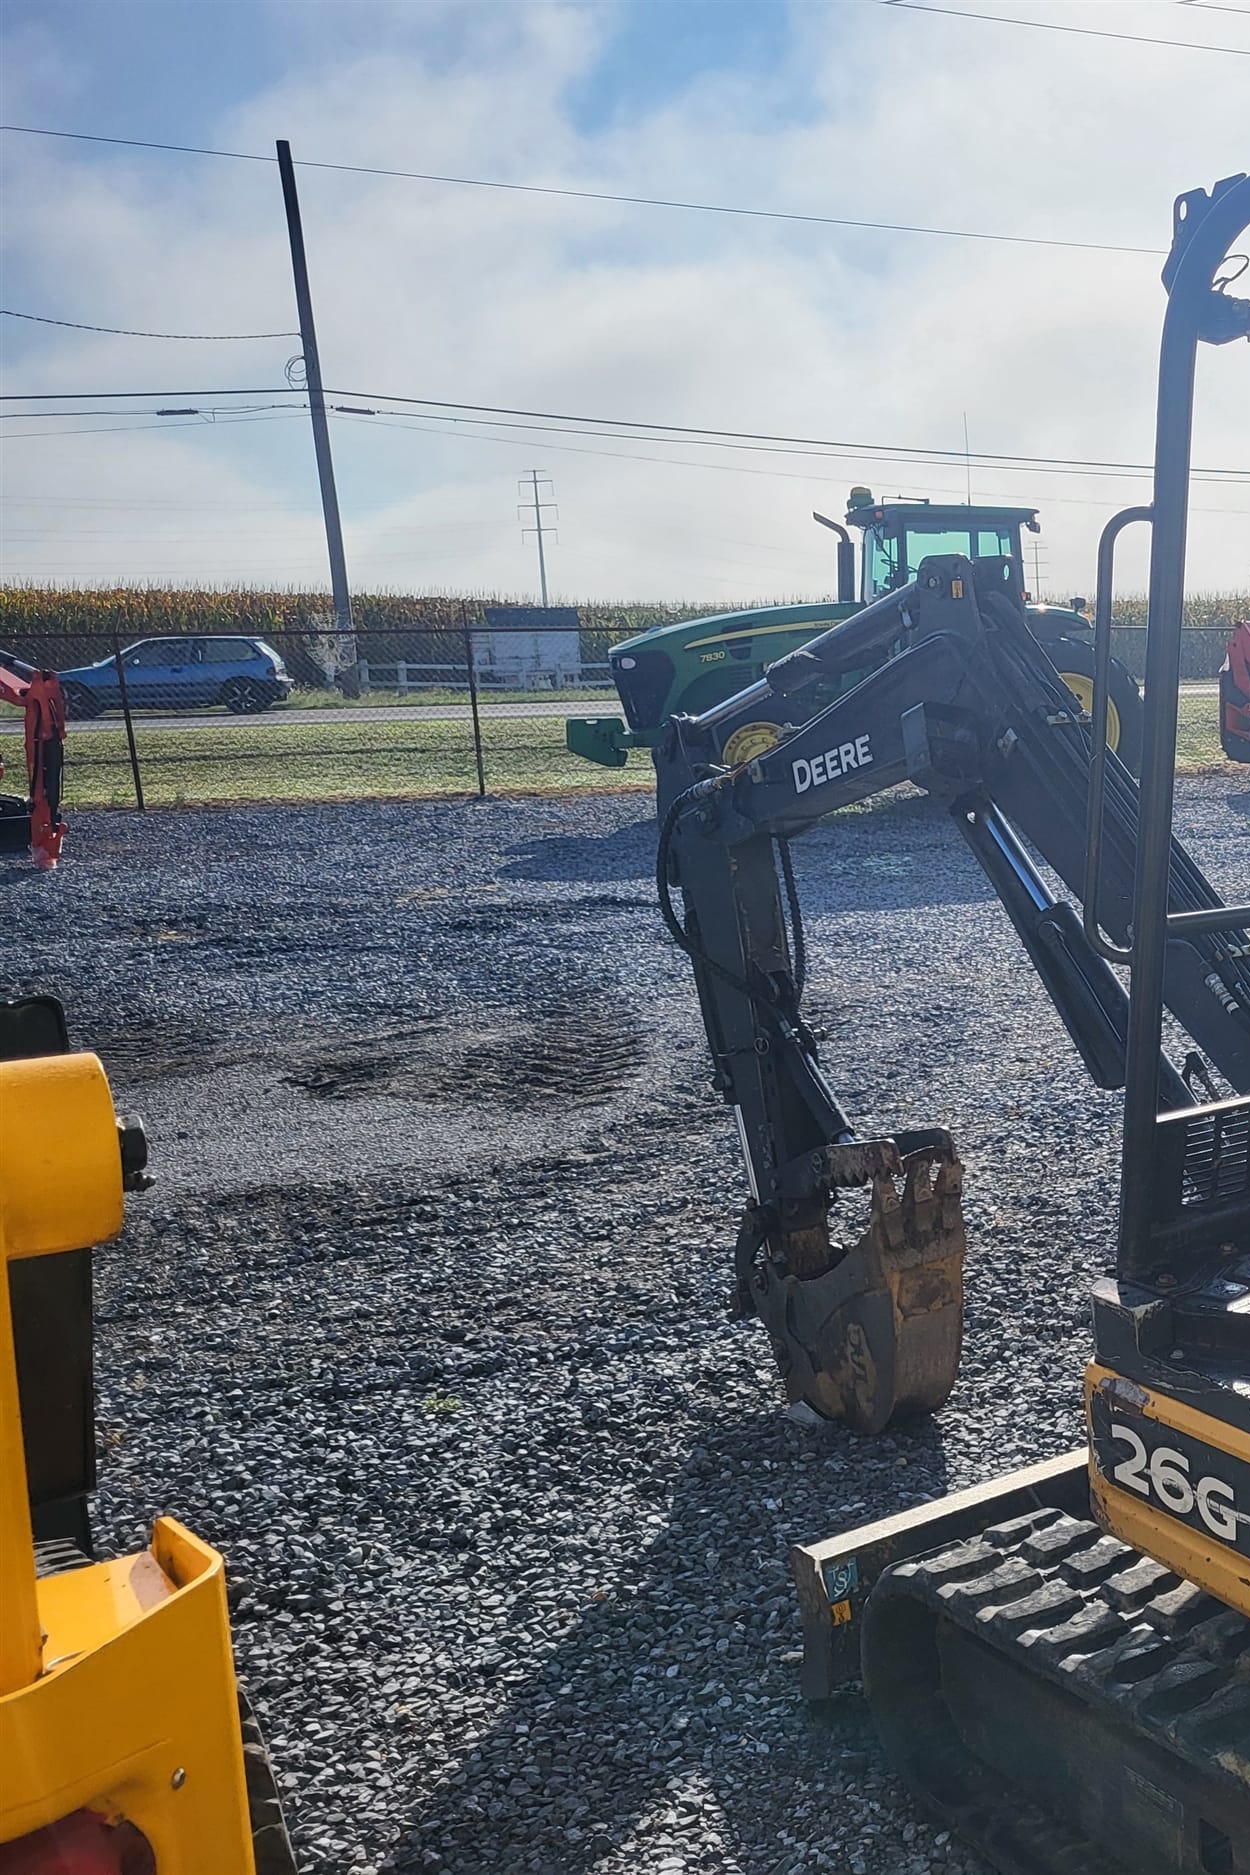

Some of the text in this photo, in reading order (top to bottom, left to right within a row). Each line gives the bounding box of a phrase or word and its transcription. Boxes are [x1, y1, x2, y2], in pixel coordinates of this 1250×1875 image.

[699, 651, 726, 663] 7830
[792, 734, 873, 793] DEERE
[1111, 1424, 1237, 1541] 26G
